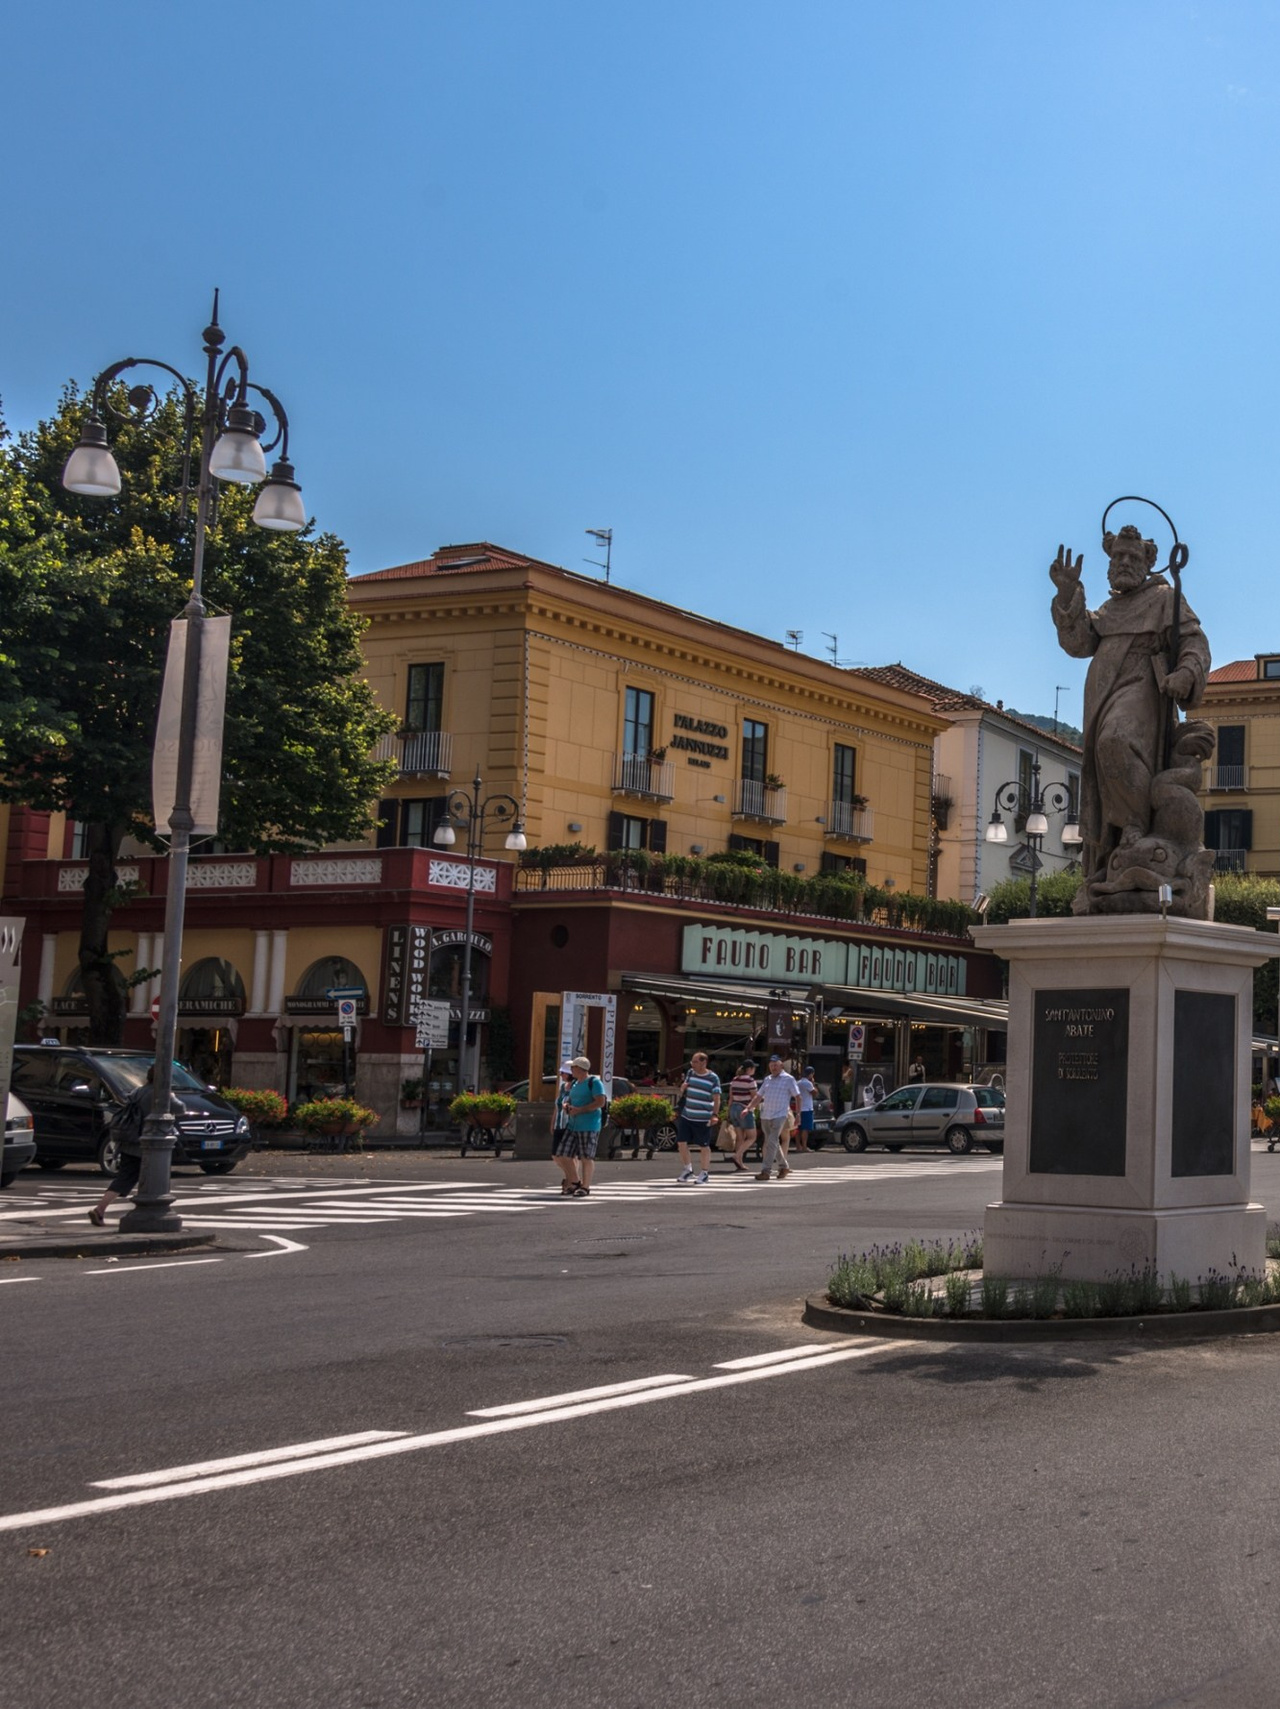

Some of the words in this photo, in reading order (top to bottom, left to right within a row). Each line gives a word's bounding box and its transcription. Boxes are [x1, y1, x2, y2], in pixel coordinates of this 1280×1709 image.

[674, 713, 728, 739] PALAZZO
[670, 734, 729, 760] JANNUZZI
[413, 927, 428, 969] WOOD
[701, 937, 770, 969] FAUNO
[785, 947, 822, 975] BAR
[387, 931, 404, 1019] LINENS
[861, 955, 914, 984] FAUNO
[928, 963, 957, 988] BAR
[179, 1000, 235, 1010] ERAMICHE
[575, 993, 602, 1001] SORRENTO
[1065, 1024, 1094, 1037] ABATE
[604, 1009, 615, 1083] PICASSO
